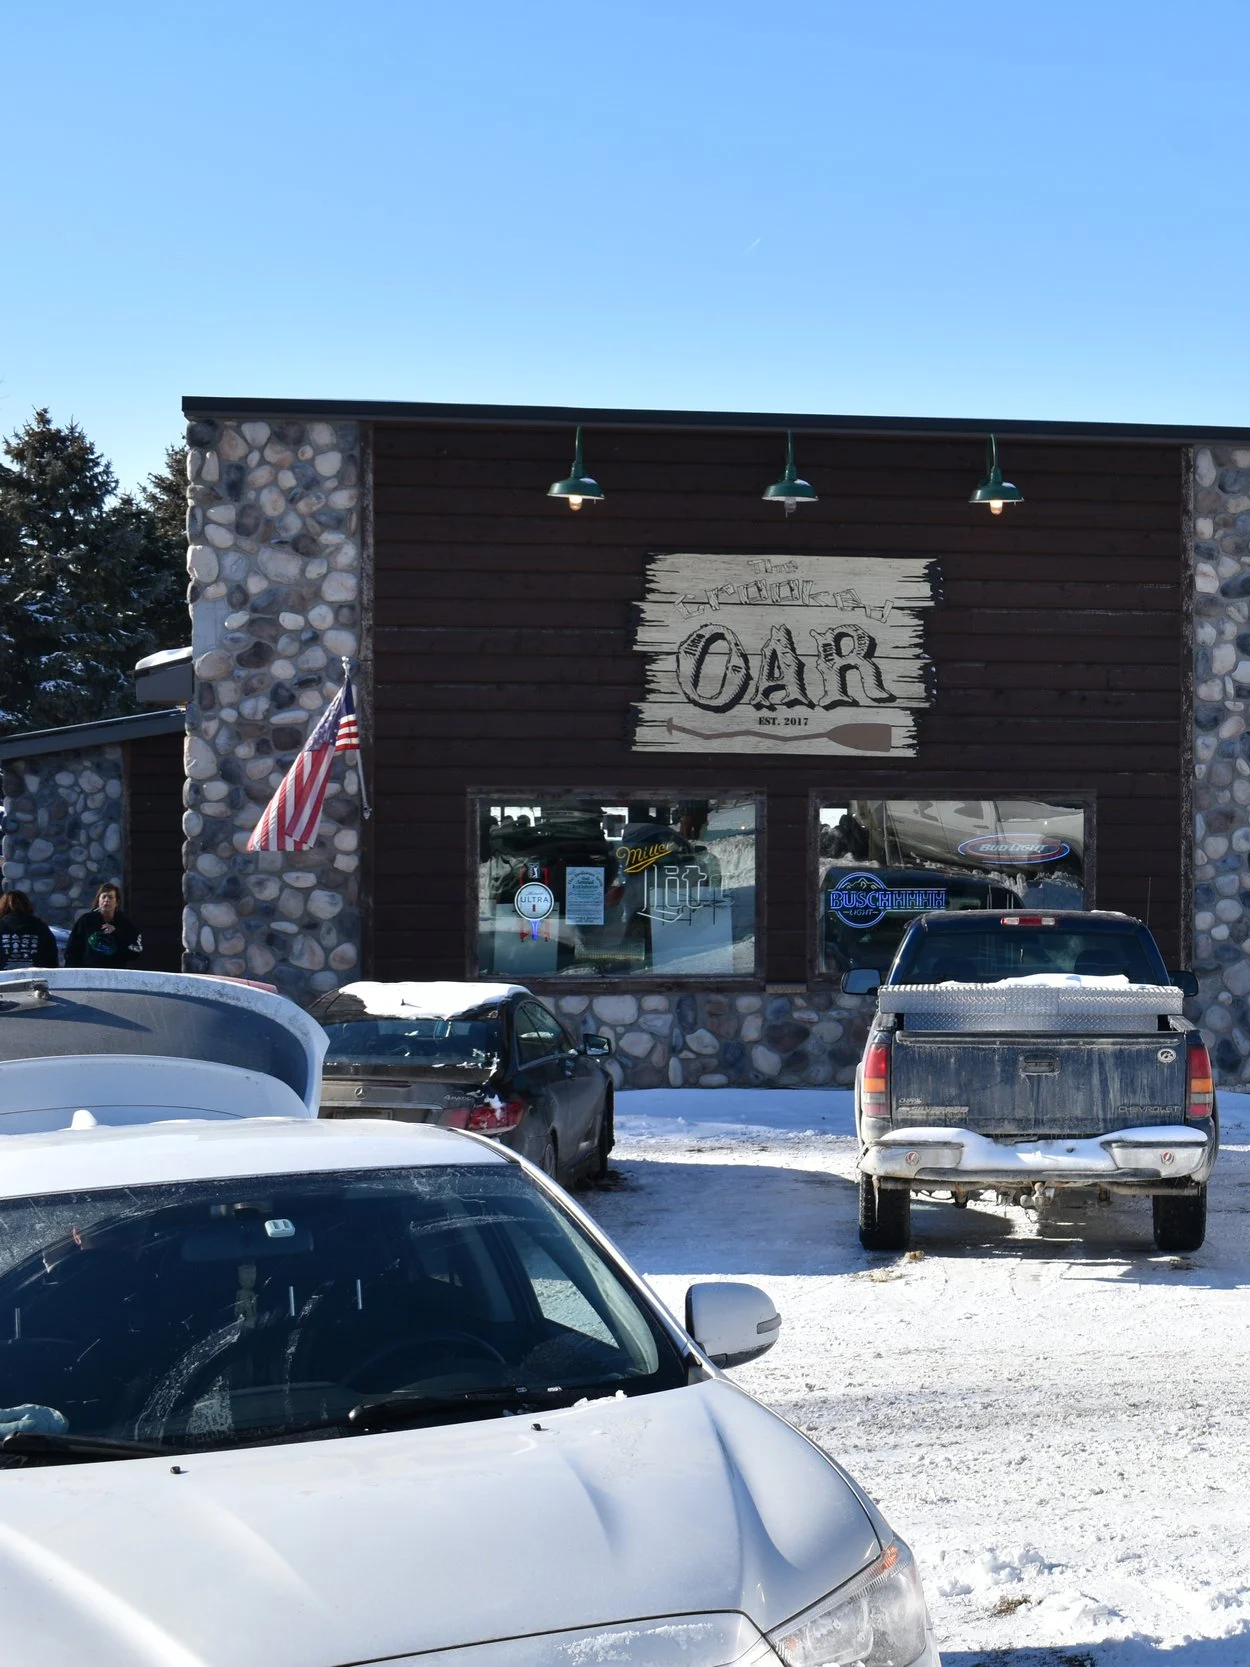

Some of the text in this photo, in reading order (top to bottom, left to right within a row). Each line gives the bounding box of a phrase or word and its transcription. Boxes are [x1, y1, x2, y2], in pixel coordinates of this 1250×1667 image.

[747, 558, 799, 574] The
[676, 623, 897, 713] OAR
[758, 716, 809, 726] EST. 2017
[616, 841, 674, 866] Miller
[1118, 1105, 1182, 1113] CHEVROLET
